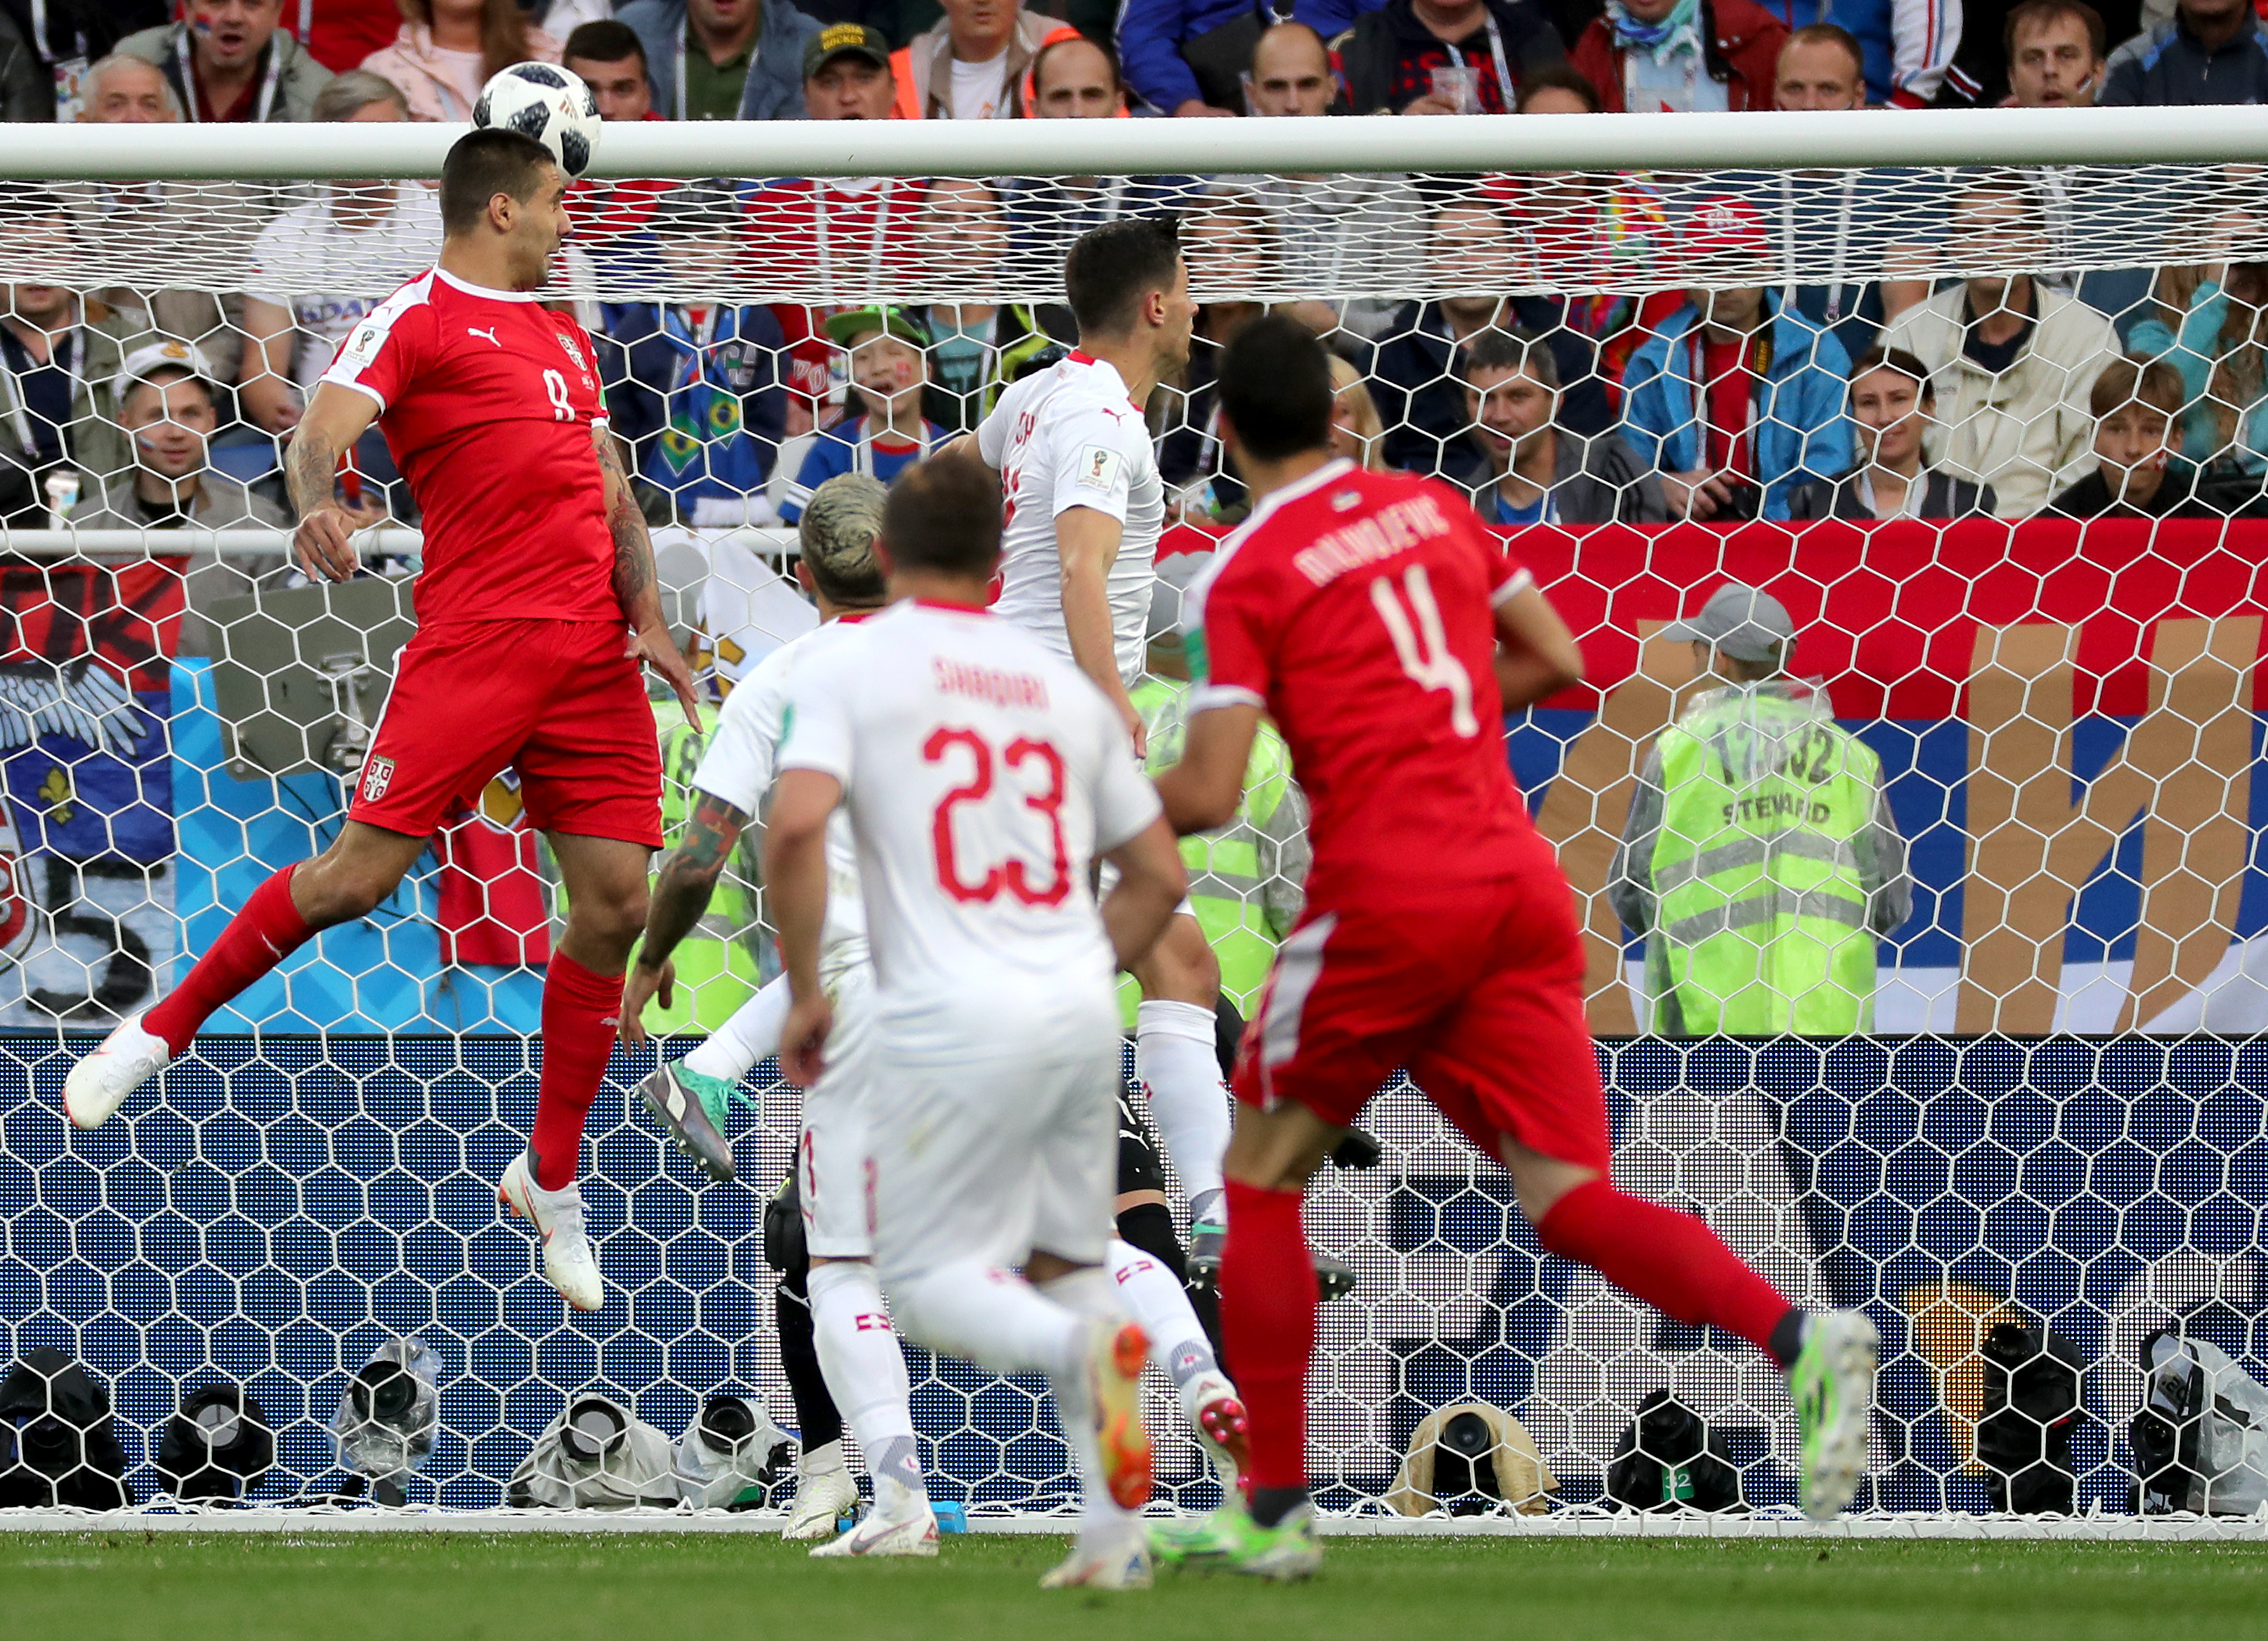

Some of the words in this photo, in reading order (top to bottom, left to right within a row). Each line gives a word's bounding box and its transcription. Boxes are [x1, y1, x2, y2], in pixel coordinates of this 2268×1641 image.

[542, 368, 575, 422] 9
[1369, 562, 1480, 738] 4
[923, 727, 1070, 908] 23
[1723, 792, 1831, 826] STEWARD
[25, 857, 167, 1020] 5
